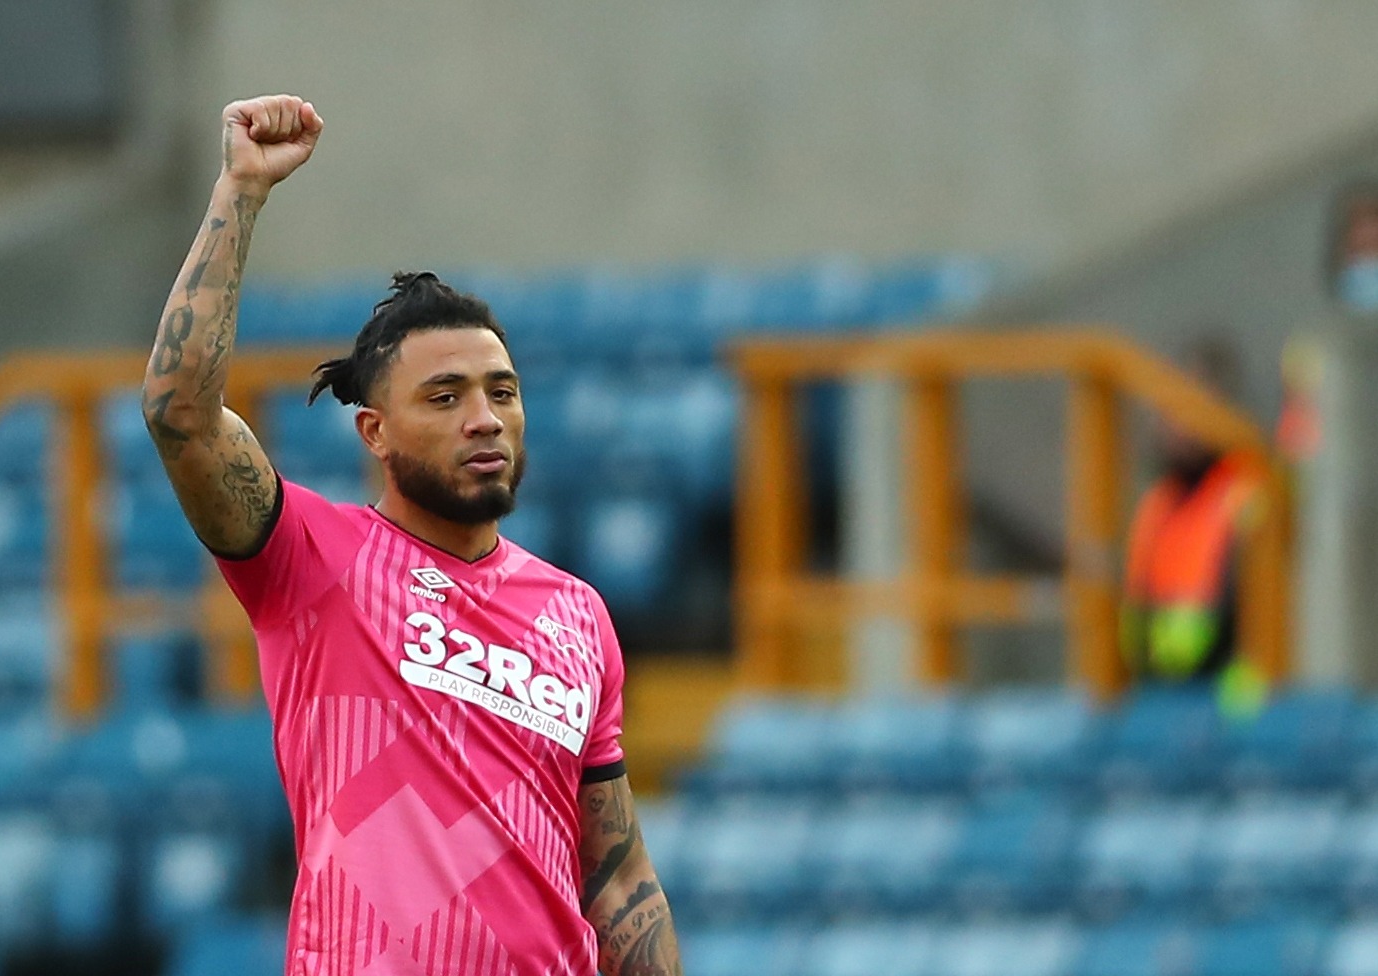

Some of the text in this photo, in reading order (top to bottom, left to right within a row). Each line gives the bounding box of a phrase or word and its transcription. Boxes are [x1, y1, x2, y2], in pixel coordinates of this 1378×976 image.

[410, 584, 447, 603] umbro
[403, 612, 592, 736] 32Red
[428, 672, 570, 741] PLAY RESPONSIBLY
